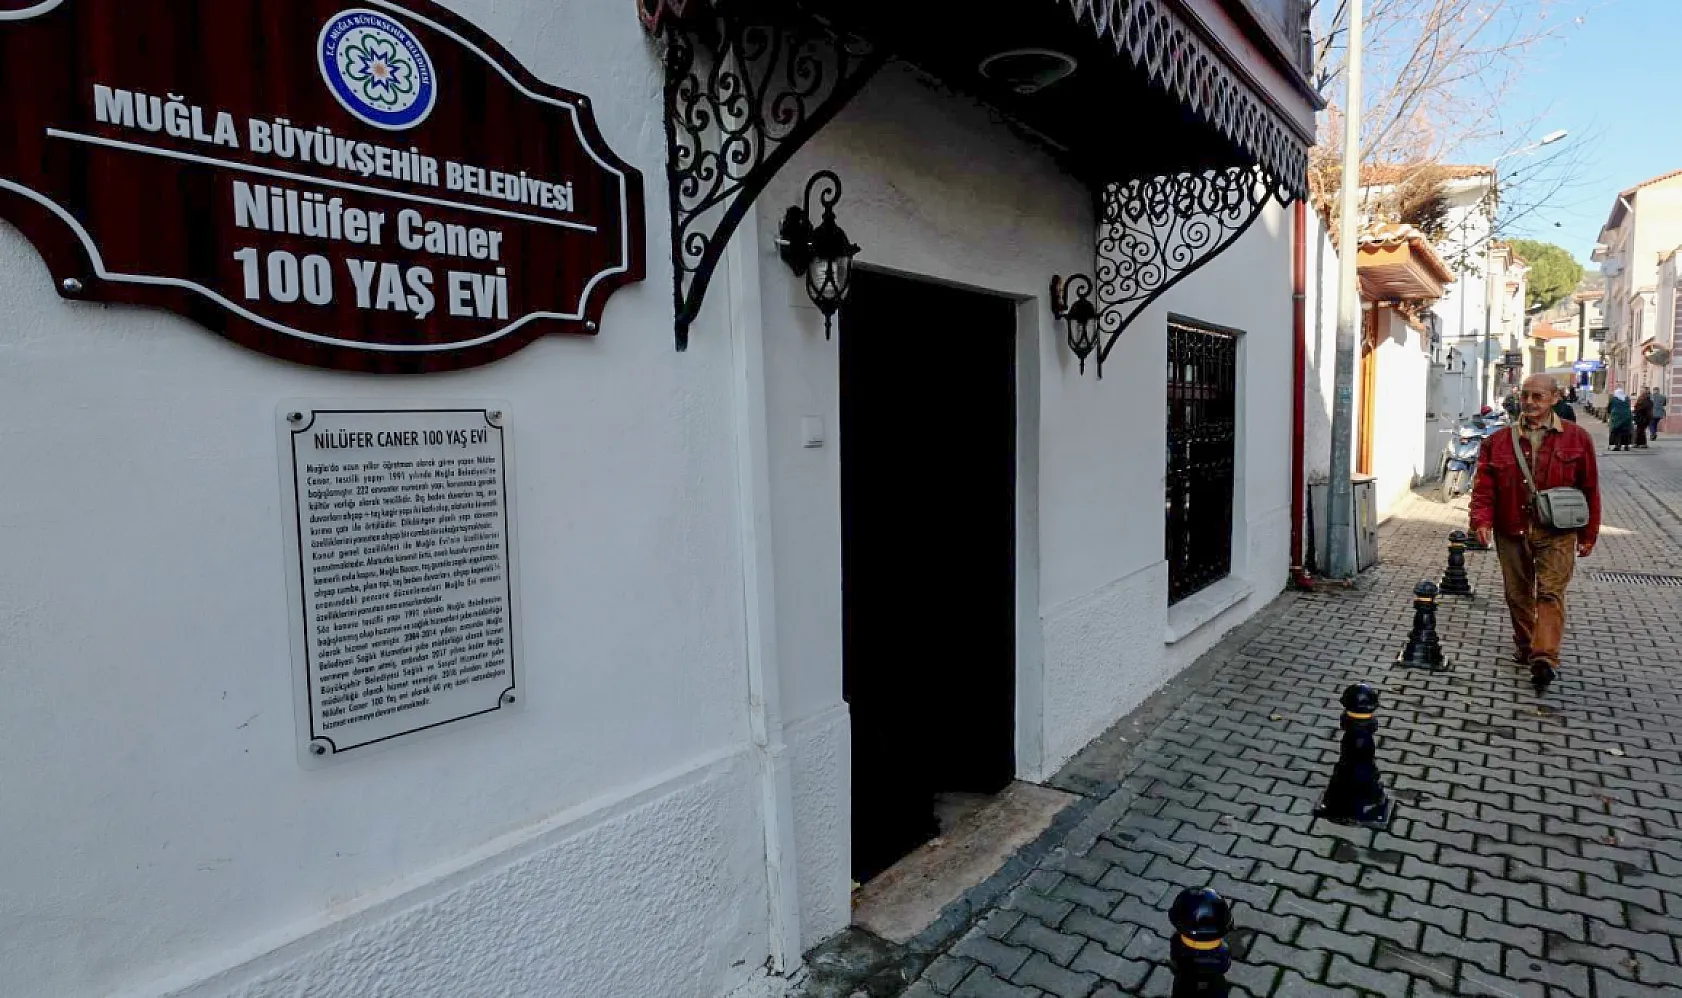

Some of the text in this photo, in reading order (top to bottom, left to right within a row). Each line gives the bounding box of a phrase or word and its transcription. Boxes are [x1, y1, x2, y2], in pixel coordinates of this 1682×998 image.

[94, 84, 574, 213] MUĞLA BÜYÜKŞEHİR BELEDİYESİ
[233, 180, 503, 262] Nilüfer Caner
[233, 247, 509, 321] 100 YAŞ EVİ
[314, 426, 487, 449] NİLÜFER CANER 100 YAŞ EVİ
[390, 472, 405, 480] 1991
